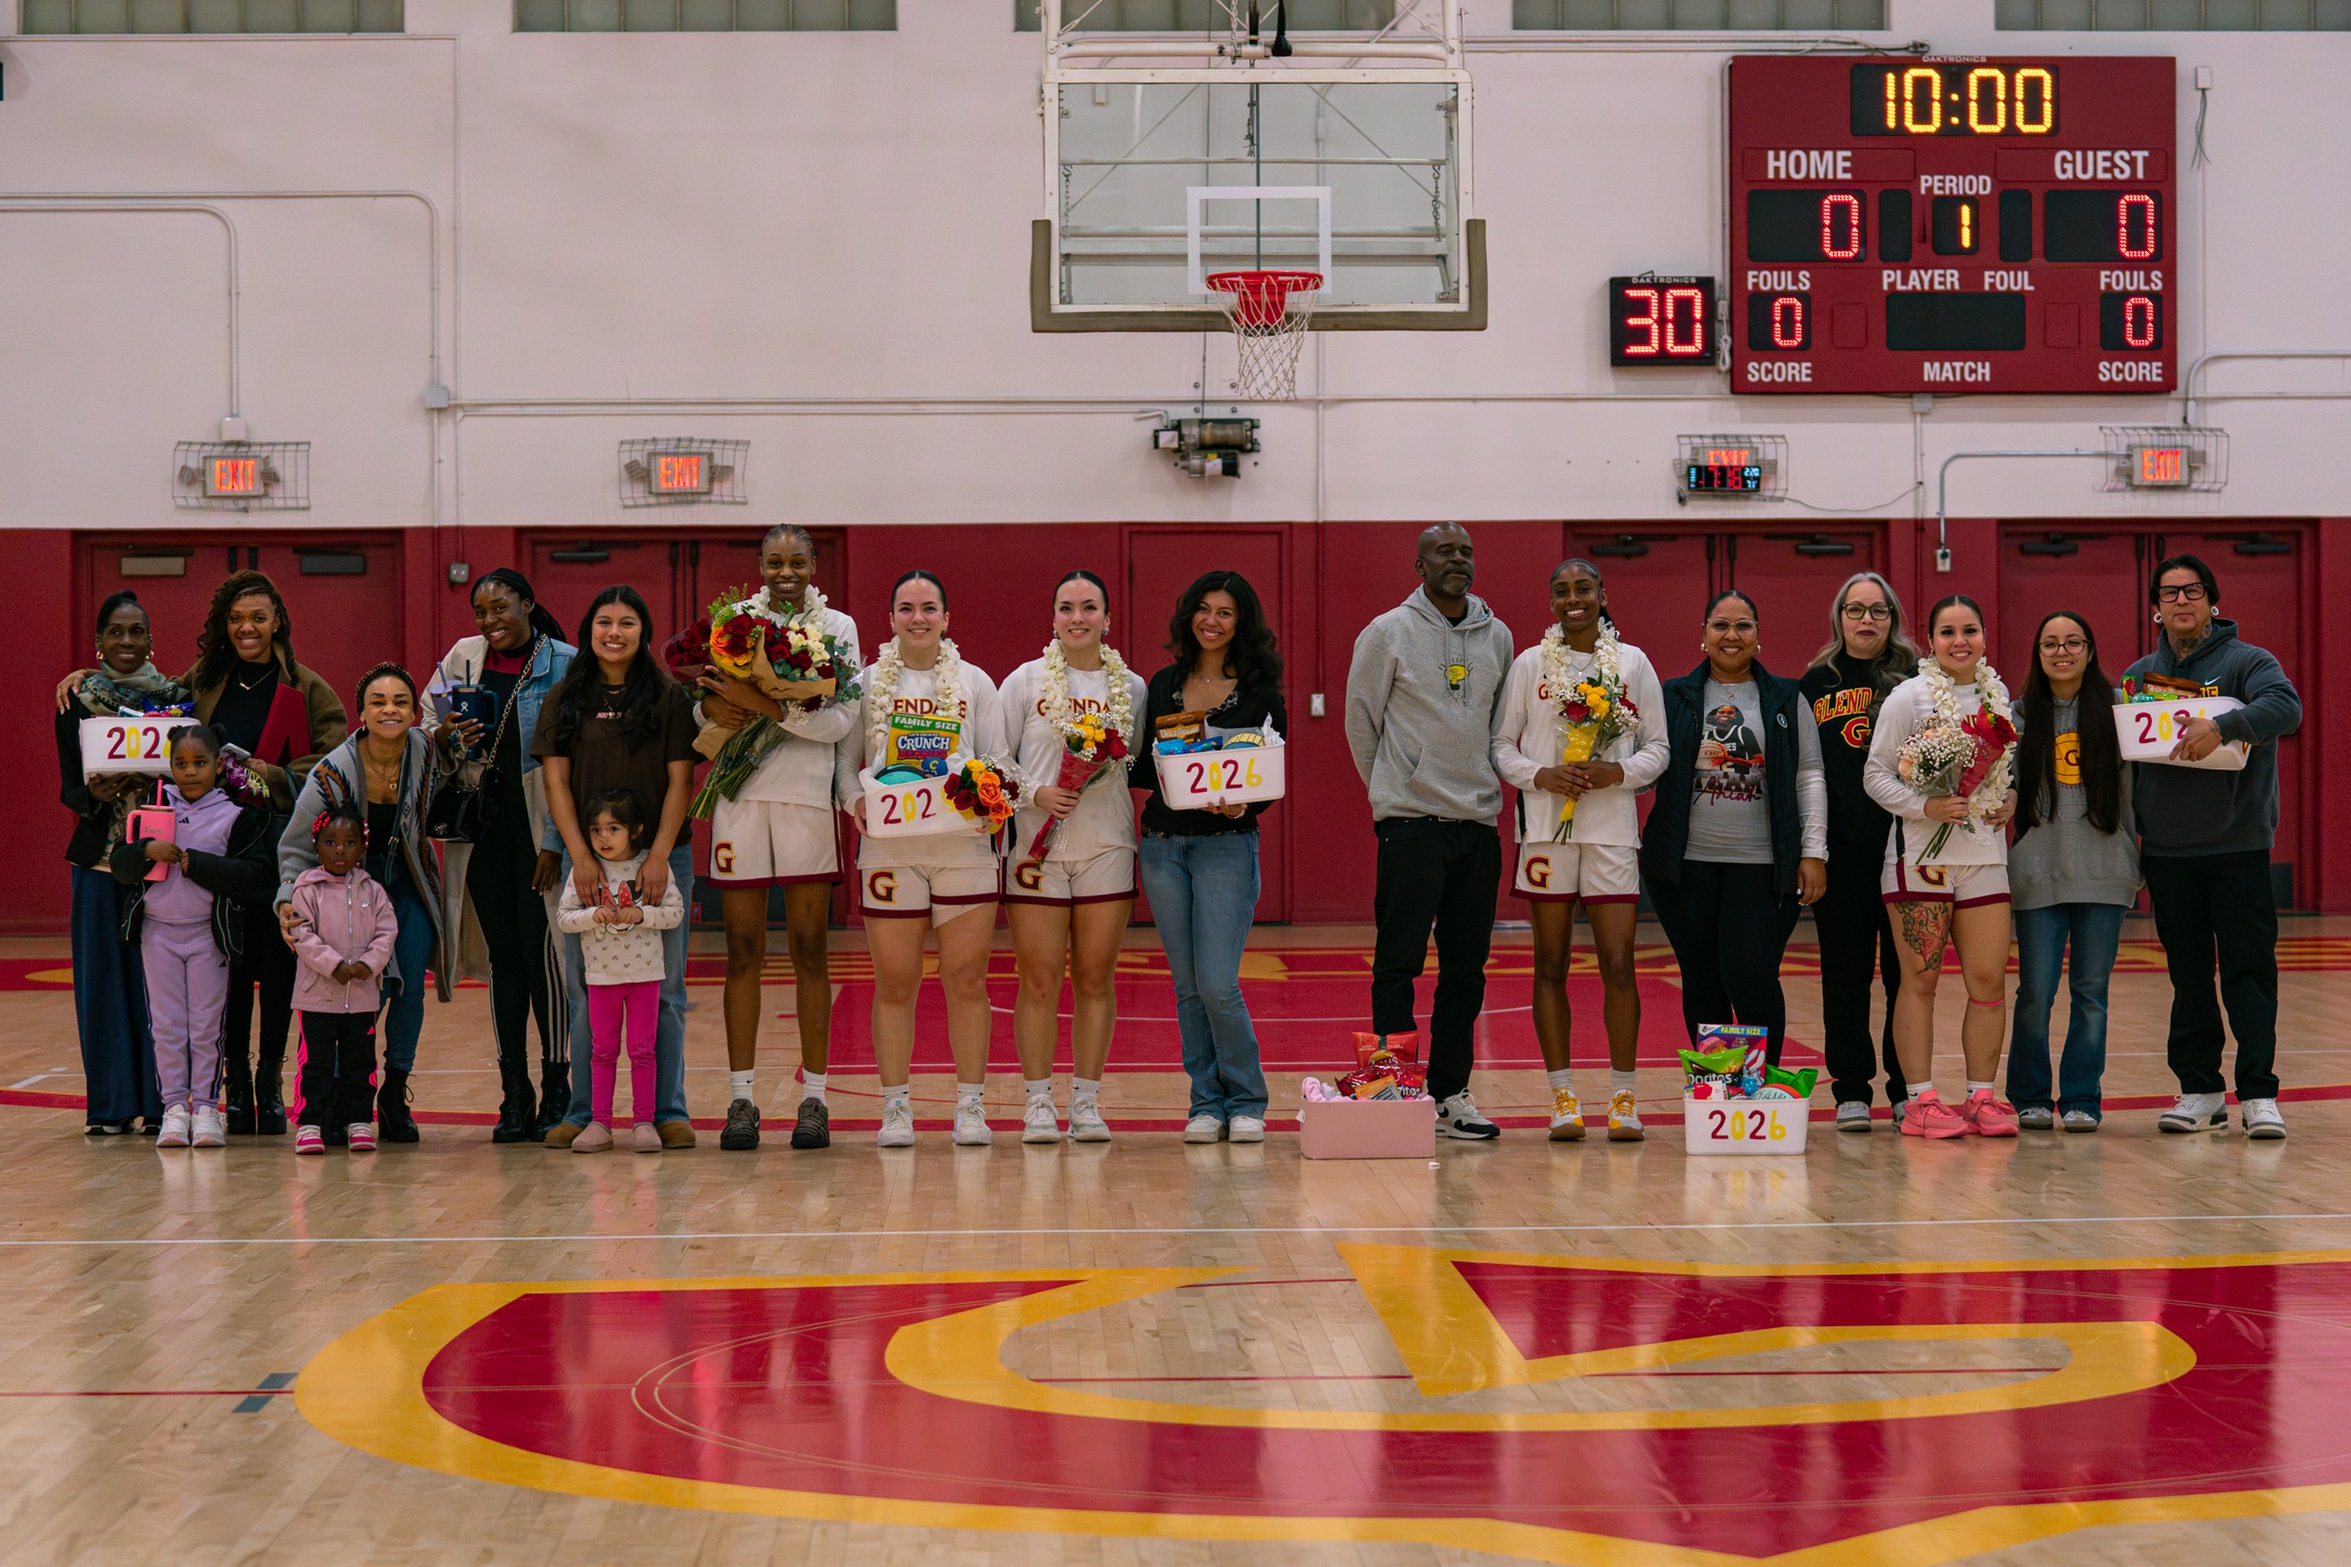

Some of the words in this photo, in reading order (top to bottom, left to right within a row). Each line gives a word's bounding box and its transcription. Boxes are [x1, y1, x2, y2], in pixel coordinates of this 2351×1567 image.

[1886, 68, 2053, 134] 10:00
[1767, 150, 1853, 179] HOME
[2054, 150, 2150, 180] GUEST
[1920, 175, 1992, 195] PERIOD
[1822, 194, 1860, 259] 0
[1960, 204, 1971, 249] 1
[2118, 194, 2156, 259] 0
[1747, 270, 1811, 291] FOULS
[1882, 269, 1960, 290] PLAYER
[1984, 271, 2035, 291] FOUL
[2100, 270, 2163, 291] FOULS
[1624, 287, 1703, 355] 30
[1772, 296, 1803, 348] 0
[2123, 296, 2155, 347] 0
[1747, 362, 1812, 382] SCORE
[1923, 362, 1991, 382] MATCH
[2098, 361, 2163, 382] SCORE
[215, 459, 256, 491] EXIT
[659, 456, 702, 489] EXIT
[2142, 449, 2182, 481] EXIT
[894, 716, 933, 728] FAMILY
[935, 721, 958, 731] SIZE
[1840, 716, 1872, 748] G
[2135, 708, 2206, 744] 202
[897, 735, 951, 751] CRUNCH
[897, 750, 947, 760] BERRIES
[1186, 757, 1263, 794] 2026
[714, 840, 736, 875] G
[1525, 855, 1553, 890] G
[868, 870, 899, 904] G
[1012, 860, 1046, 893] G
[1721, 1027, 1745, 1035] FAMILY
[1708, 1110, 1786, 1141] 2026
